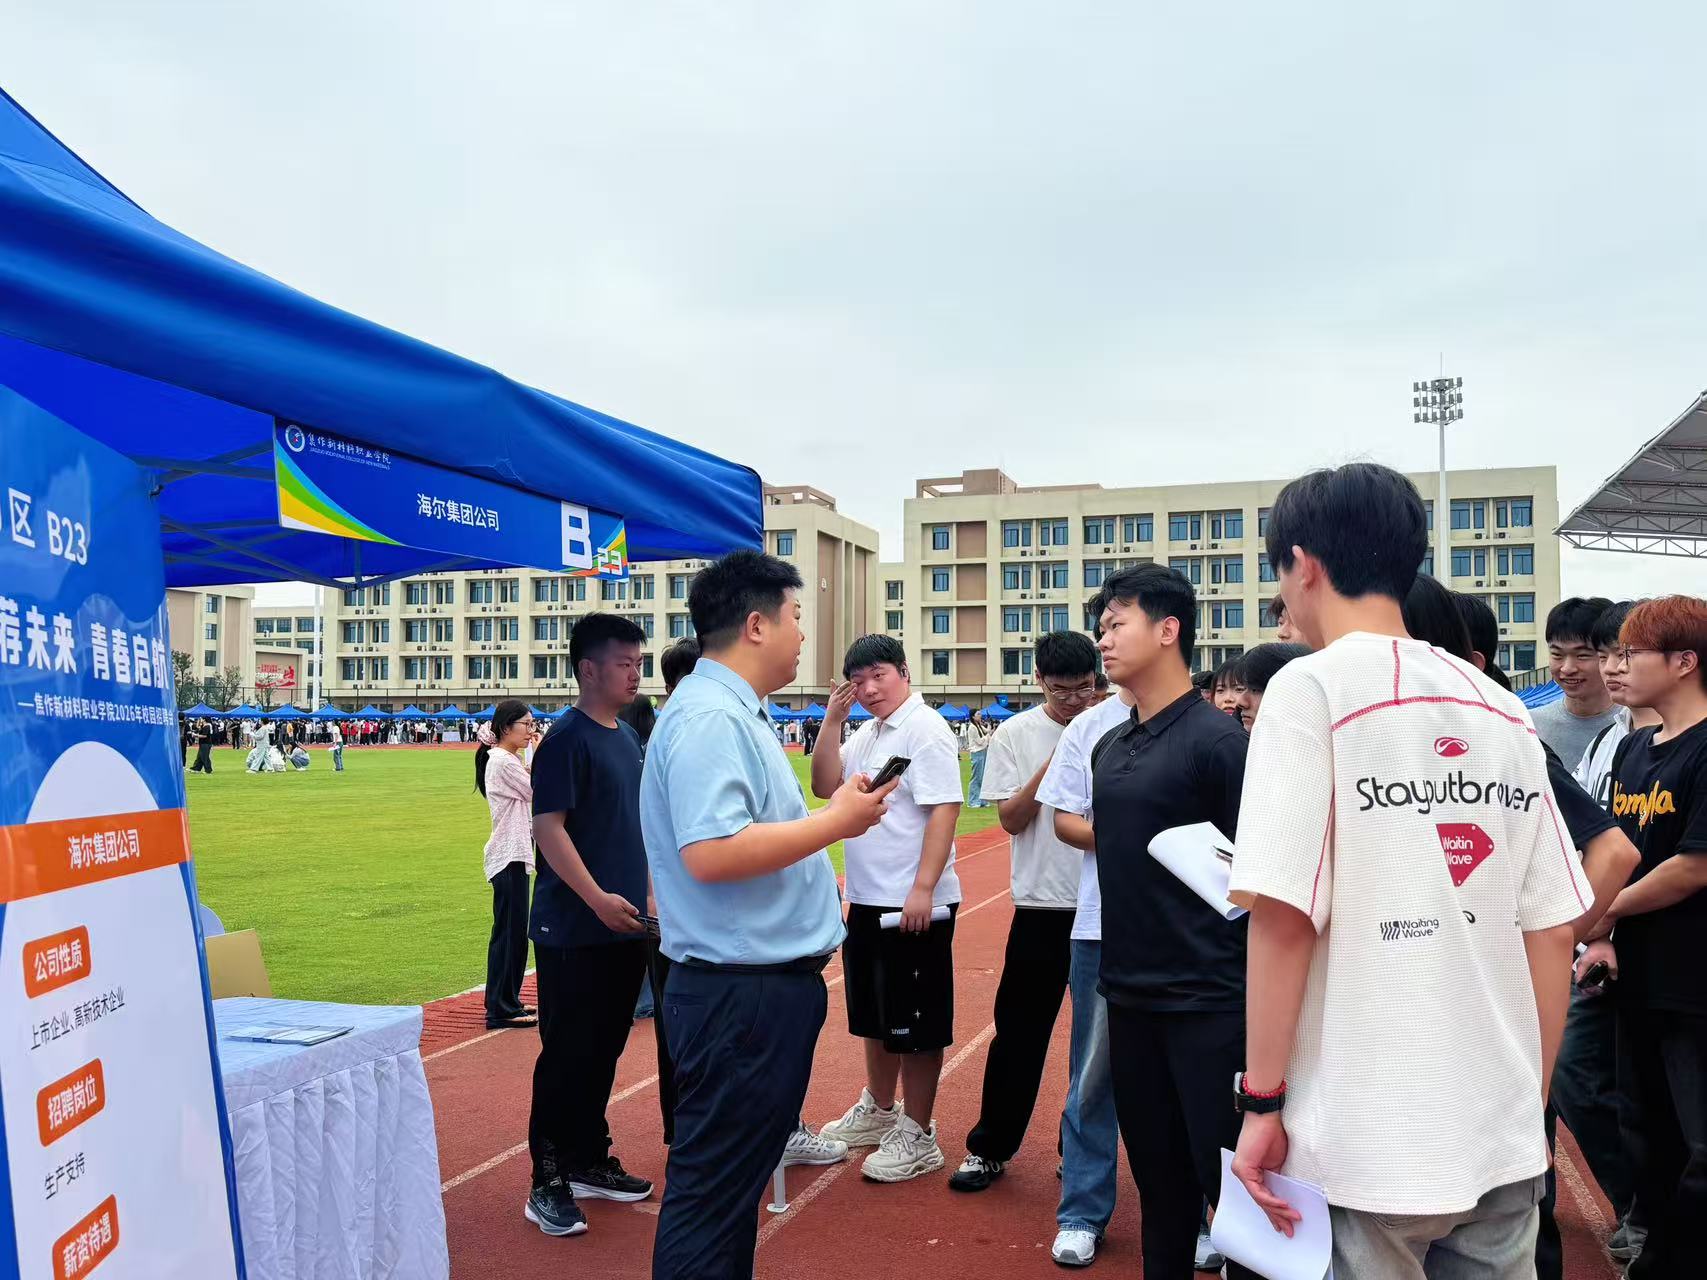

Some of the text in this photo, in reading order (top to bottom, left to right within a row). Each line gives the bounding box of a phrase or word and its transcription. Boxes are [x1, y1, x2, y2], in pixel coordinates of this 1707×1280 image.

[0, 487, 88, 566] 区 B23
[417, 493, 499, 531] 海尔集团公司
[561, 501, 593, 569] B
[90, 621, 169, 690] 青春启航
[67, 828, 141, 870] 海尔集团公司
[1400, 918, 1440, 929] Waiting
[1402, 928, 1434, 939] Wave
[34, 938, 83, 982] 公司性质
[31, 985, 125, 1050] 上市企业、高新技术企业
[48, 1074, 97, 1131] 招聘岗位
[44, 1152, 85, 1200] 生产支持
[62, 1211, 112, 1278] 薪资待遇
